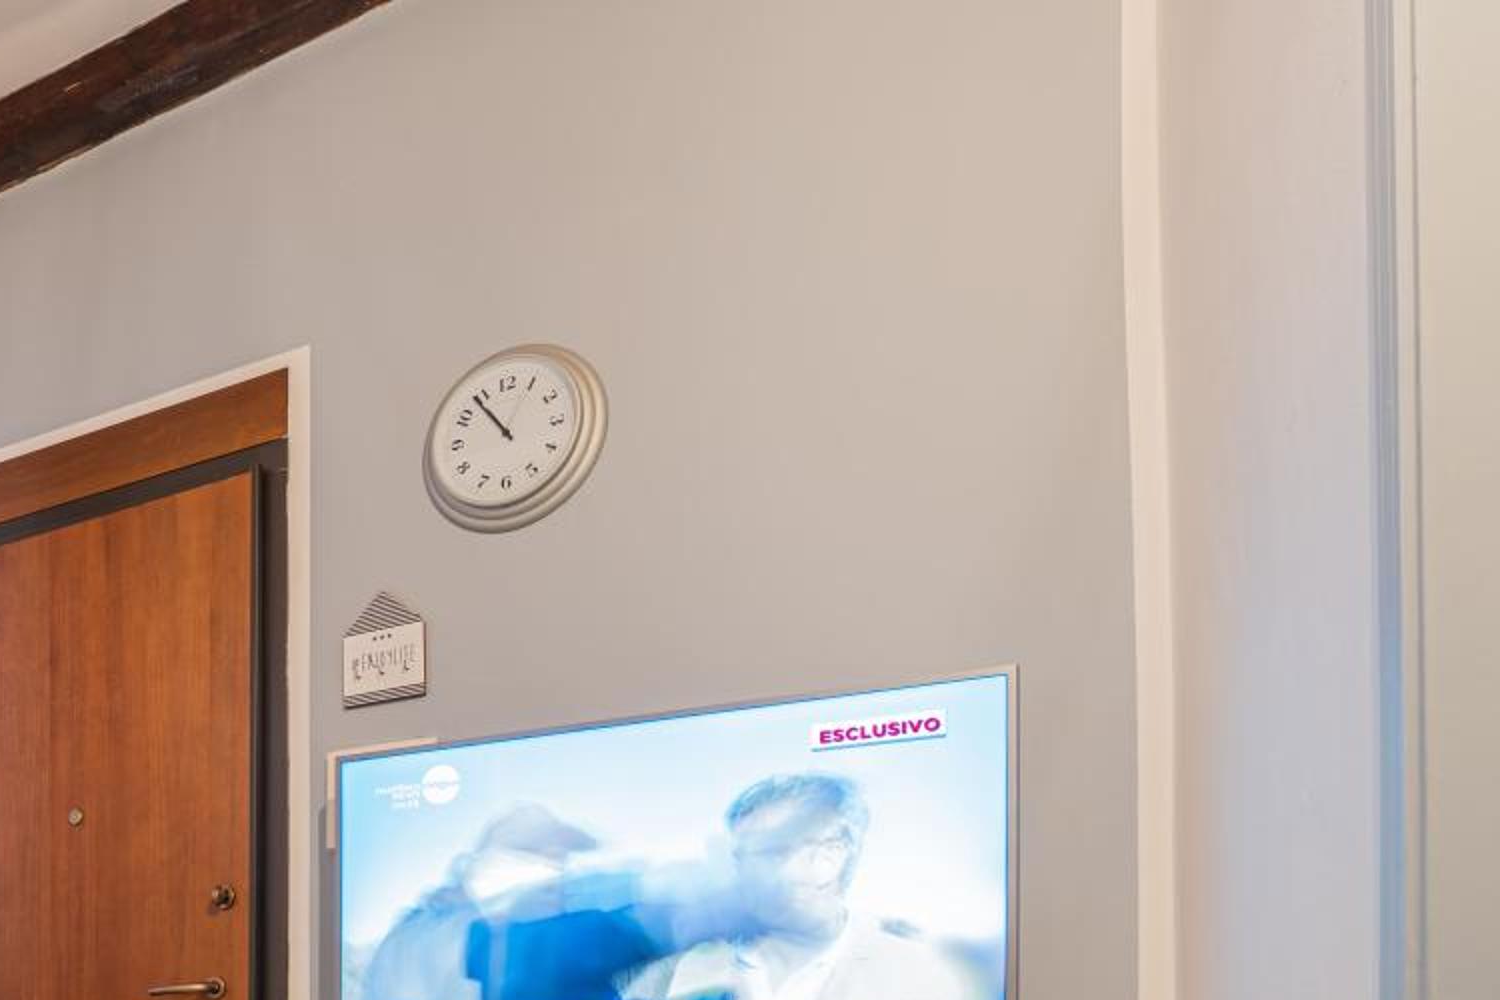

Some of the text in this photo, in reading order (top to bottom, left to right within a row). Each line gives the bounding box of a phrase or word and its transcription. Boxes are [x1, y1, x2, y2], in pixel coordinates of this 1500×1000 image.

[499, 375, 517, 392] 12
[526, 376, 537, 391] 1
[542, 389, 559, 404] 2
[456, 409, 474, 427] 10
[549, 412, 565, 427] 3
[450, 438, 465, 451] 9
[544, 441, 557, 454] 4
[455, 460, 472, 475] 8
[524, 462, 539, 478] 5
[476, 474, 491, 488] 7
[500, 475, 513, 489] 6
[817, 713, 942, 745] ESCLUSIVO
